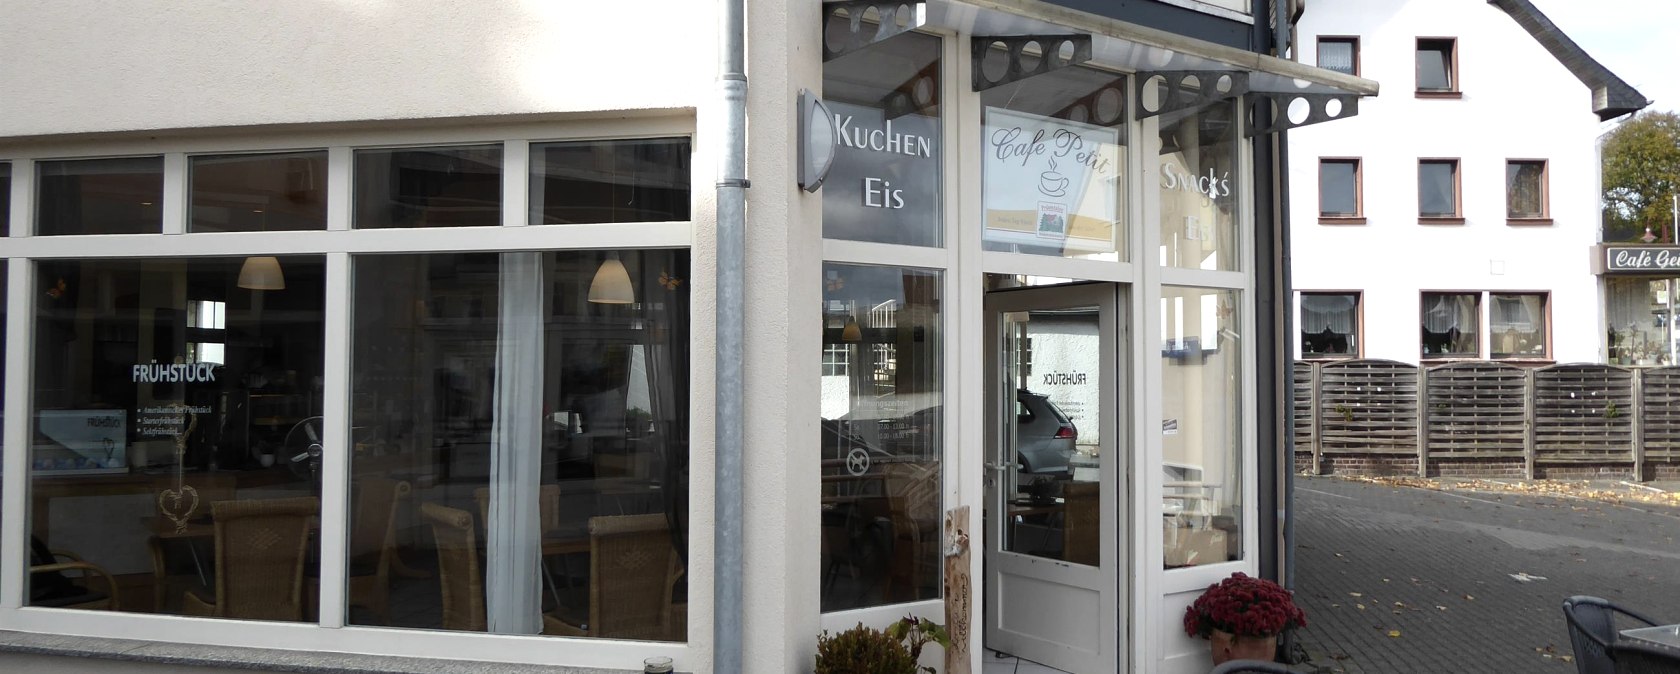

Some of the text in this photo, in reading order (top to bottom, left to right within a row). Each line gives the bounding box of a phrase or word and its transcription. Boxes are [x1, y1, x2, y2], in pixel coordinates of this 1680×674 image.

[991, 127, 1111, 174] Cafe Petit
[864, 177, 905, 210] Eis
[1615, 250, 1652, 268] Café
[132, 359, 216, 383] FRÜHSTÜCK
